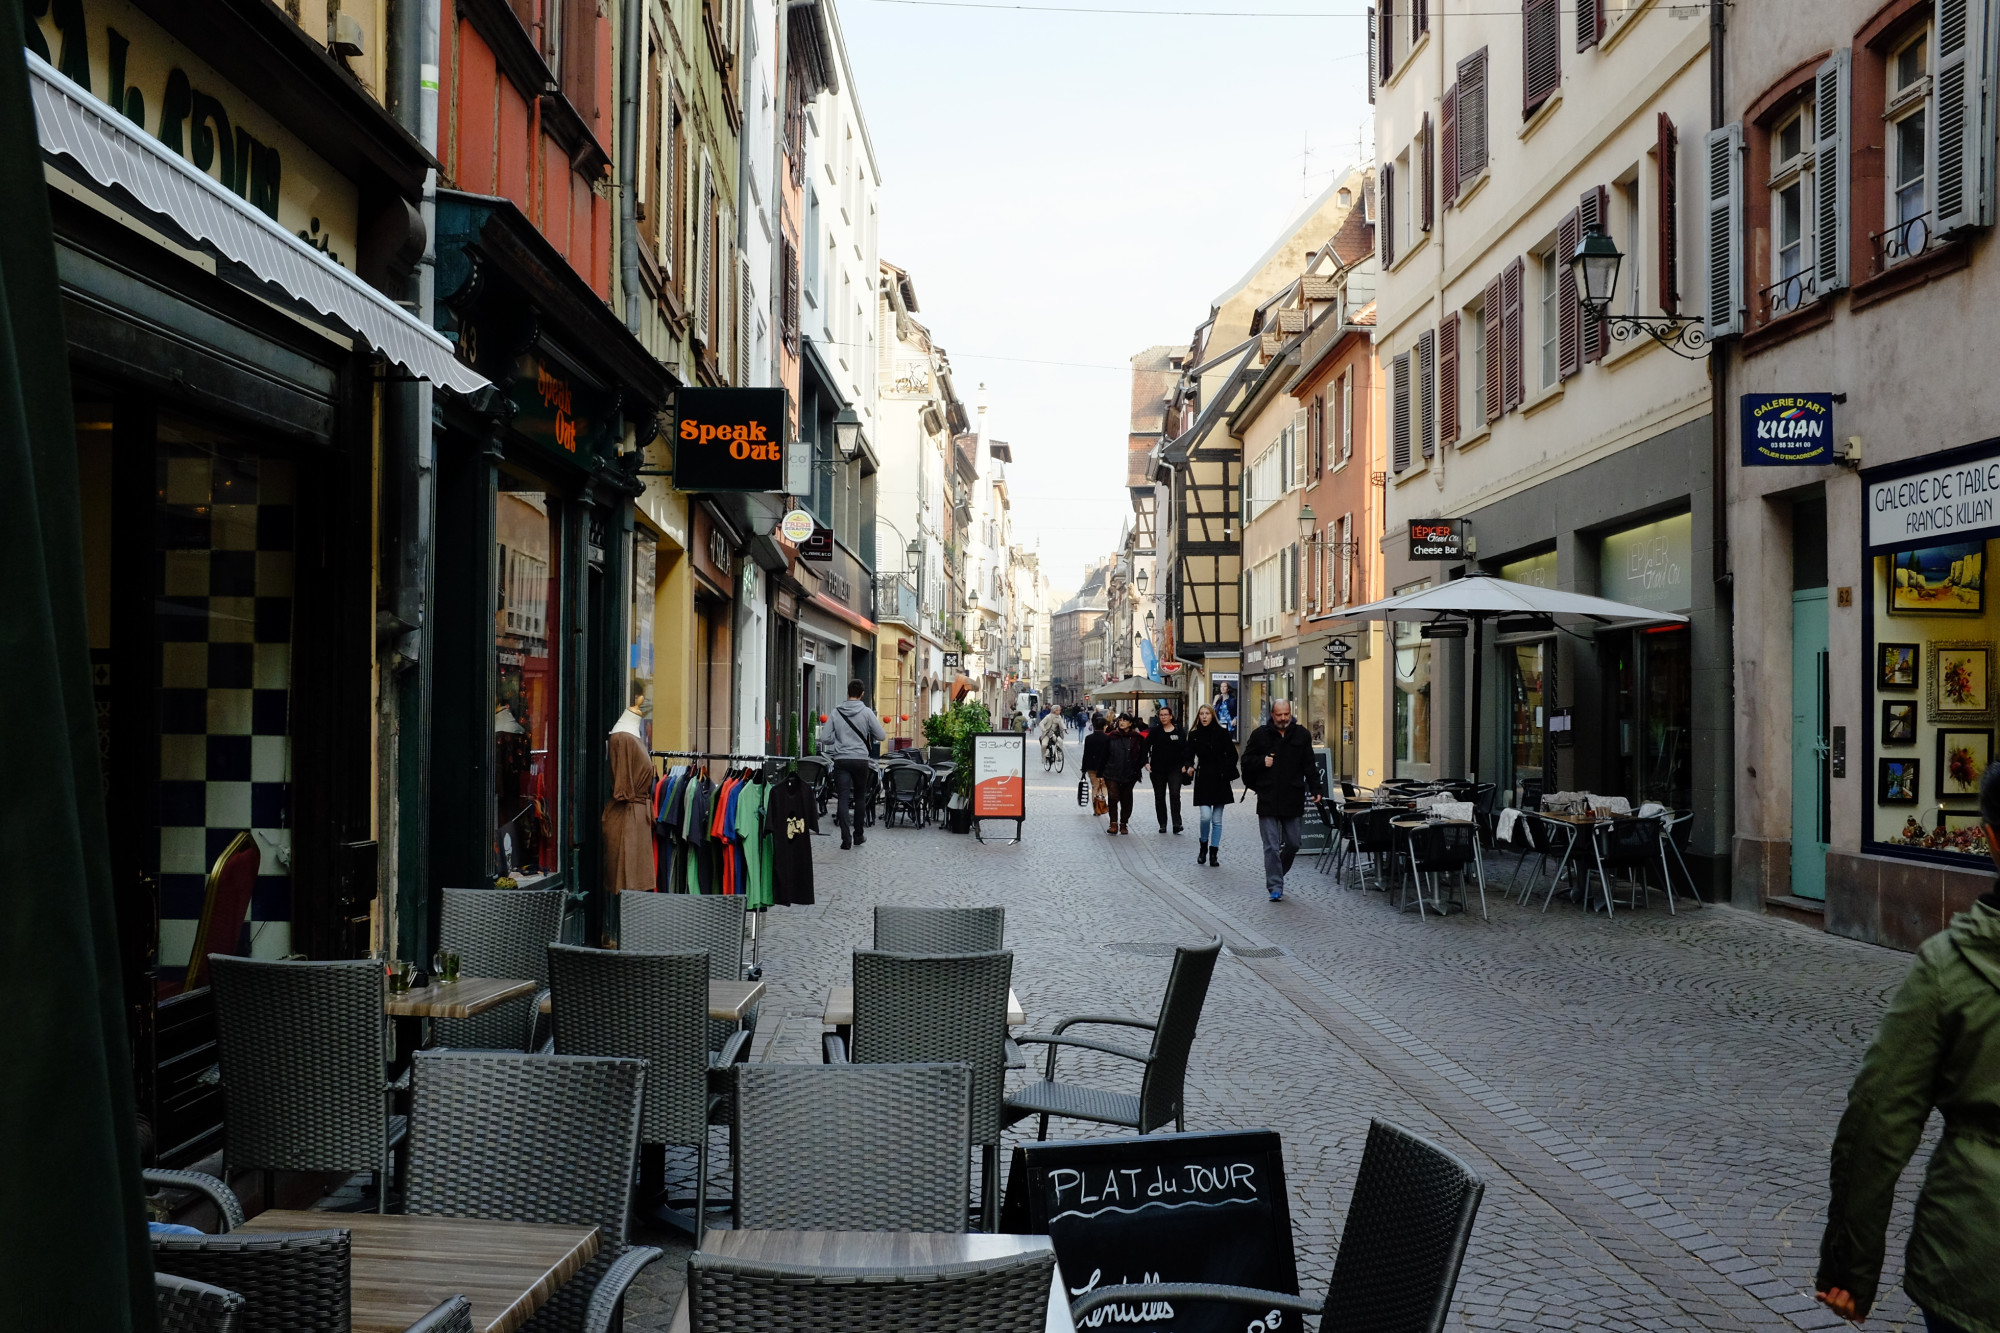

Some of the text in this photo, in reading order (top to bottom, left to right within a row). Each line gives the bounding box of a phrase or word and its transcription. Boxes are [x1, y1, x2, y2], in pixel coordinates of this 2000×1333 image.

[459, 319, 477, 364] 43
[537, 358, 572, 416] Speak
[1753, 398, 1827, 417] GALERIE D'ART
[555, 409, 576, 454] Out
[680, 420, 767, 445] Speak
[1756, 419, 1824, 439] KILIAN
[729, 440, 781, 461] Out
[1757, 446, 1825, 460] ATELIER D'ENCADREMENT
[1875, 463, 2000, 512] GALERIE DE TABLE
[1906, 497, 1993, 534] FRANCIS KILIAN
[1413, 544, 1458, 555] Cheese Bar
[1839, 590, 1850, 603] 62
[1048, 1163, 1257, 1206] PLAT du JOUR
